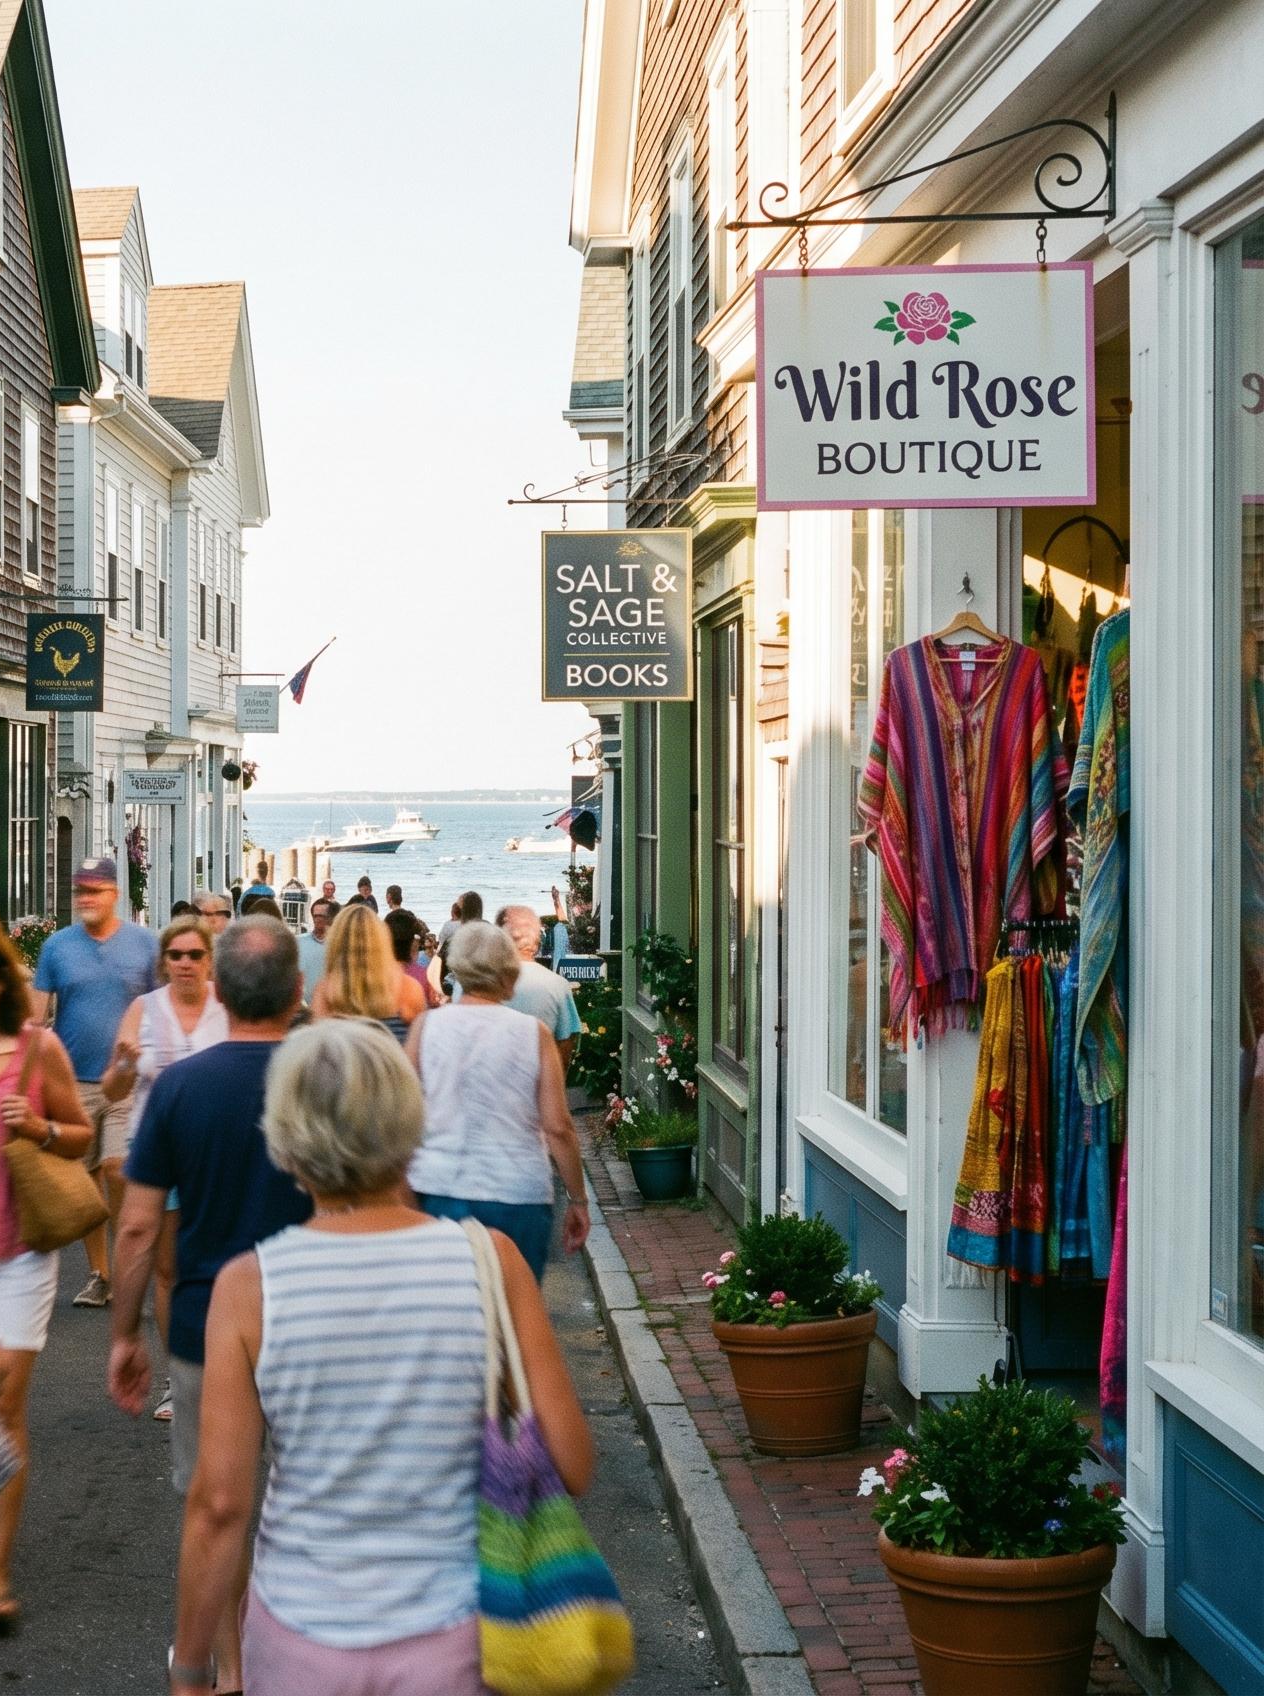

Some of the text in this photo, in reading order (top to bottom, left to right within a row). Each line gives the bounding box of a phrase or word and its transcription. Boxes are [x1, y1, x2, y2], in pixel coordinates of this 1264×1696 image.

[774, 360, 1078, 428] Wild Rose
[817, 439, 1042, 479] BOUTIQUE
[556, 563, 678, 593] SALT &
[568, 598, 665, 627] SAGE
[566, 632, 667, 645] COLLECTIVE
[566, 664, 668, 687] BOOKS
